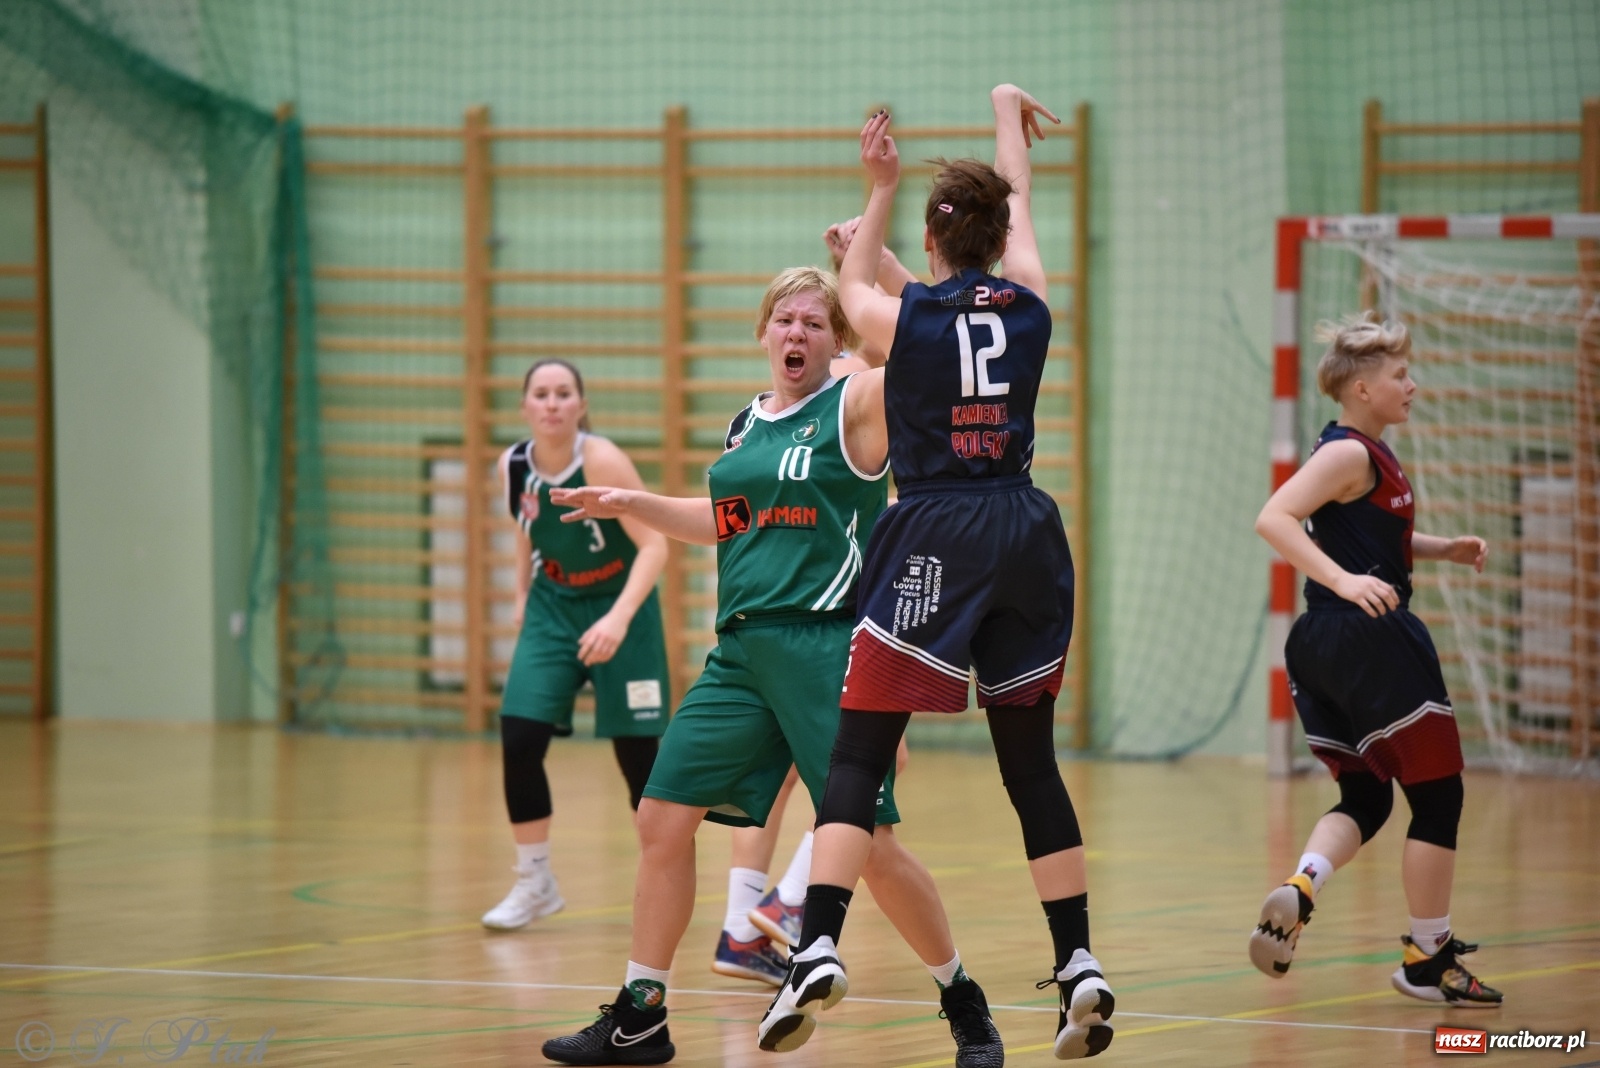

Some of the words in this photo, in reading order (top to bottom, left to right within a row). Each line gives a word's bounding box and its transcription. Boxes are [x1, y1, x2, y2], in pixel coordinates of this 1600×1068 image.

[955, 312, 1010, 398] 12
[777, 445, 813, 481] 10
[582, 518, 607, 553] 3
[902, 576, 923, 585] Work
[931, 565, 943, 603] PASSION
[902, 599, 913, 631] uks2kp
[911, 598, 922, 627] Respect
[920, 596, 931, 624] dreams
